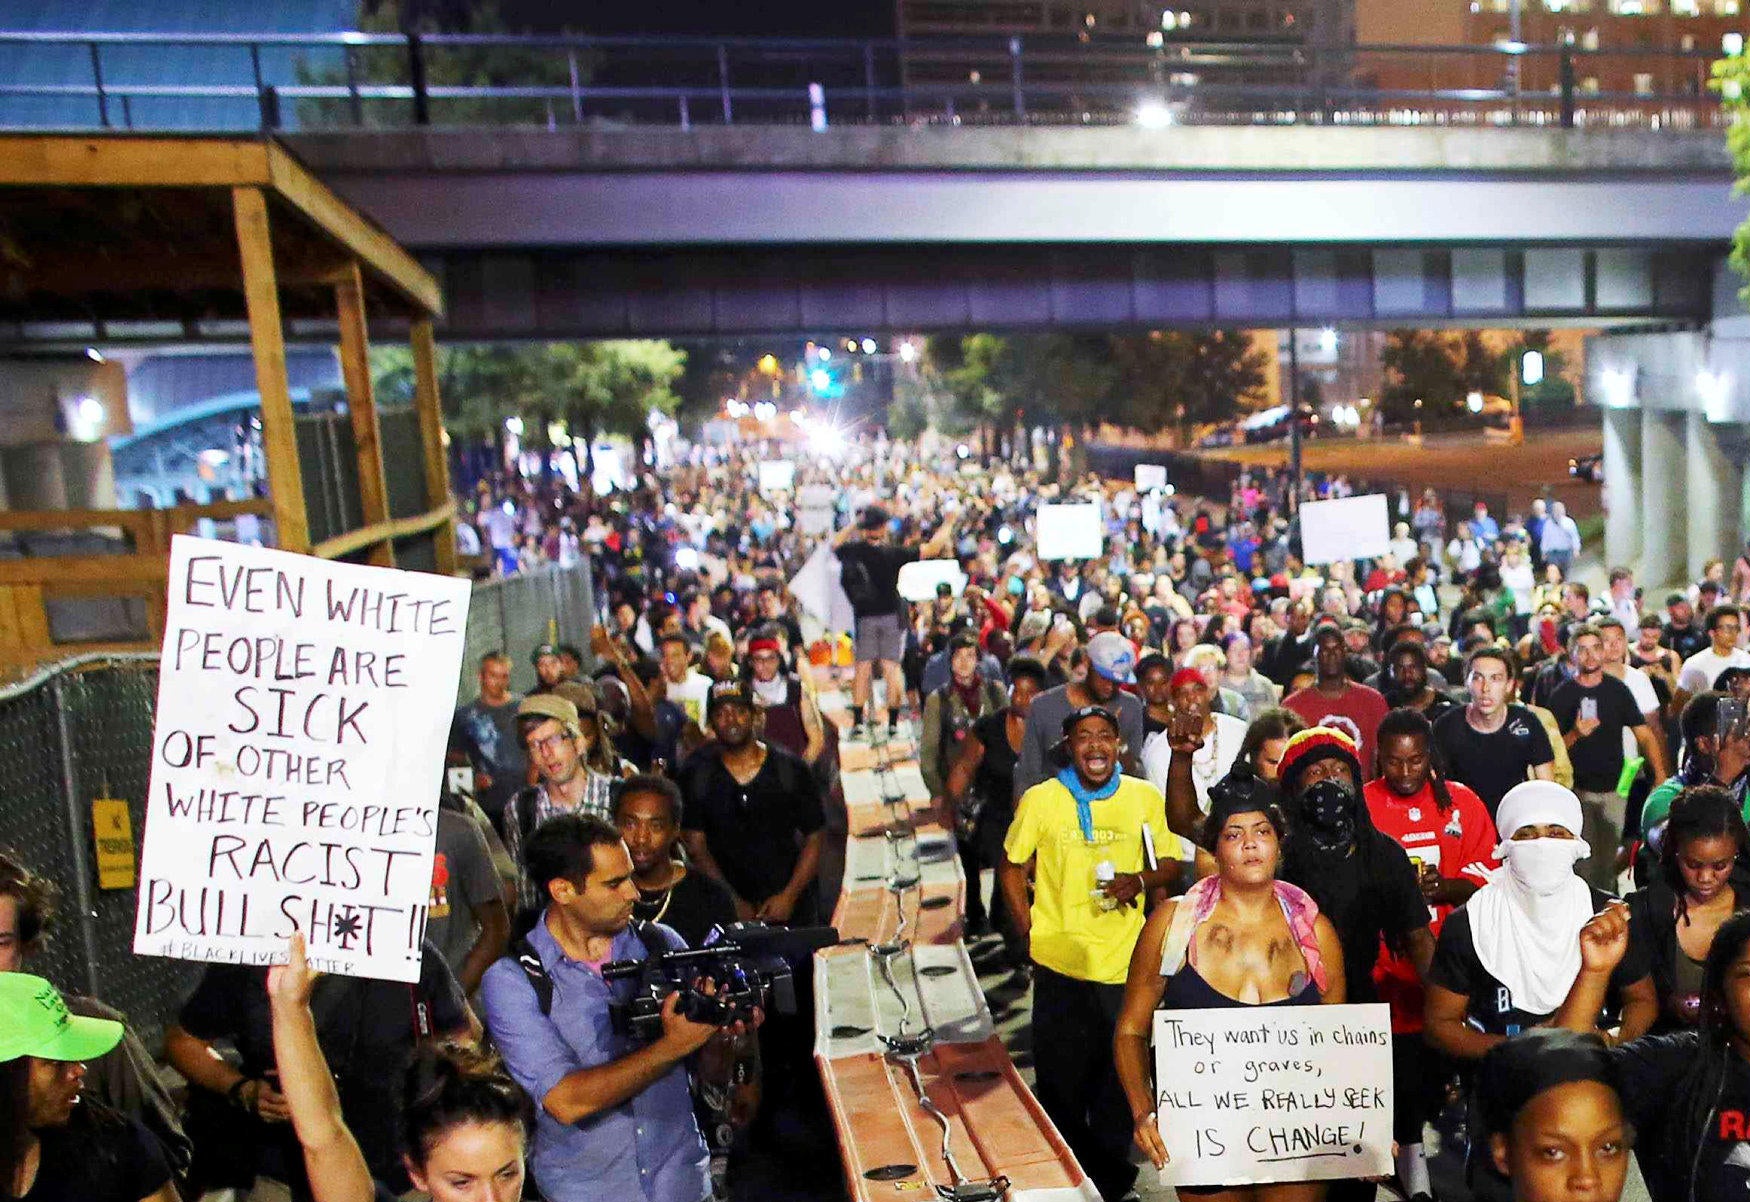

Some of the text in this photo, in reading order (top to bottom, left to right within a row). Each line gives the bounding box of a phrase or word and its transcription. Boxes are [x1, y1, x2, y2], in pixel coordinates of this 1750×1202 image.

[186, 555, 456, 635] EVEN WHITE
[175, 628, 409, 688] PEOPLE ARE
[228, 686, 369, 744] SICK
[162, 730, 351, 790] OF OTHER
[166, 782, 435, 837] WHITE PEOPLE'S
[209, 834, 422, 896] RACIST
[1164, 1019, 1387, 1054] They want us in chains
[1194, 1058, 1322, 1083] or graves,
[1158, 1086, 1386, 1113] ALL WE REALLY SEEK
[1195, 1121, 1365, 1158] IS CHANGE!
